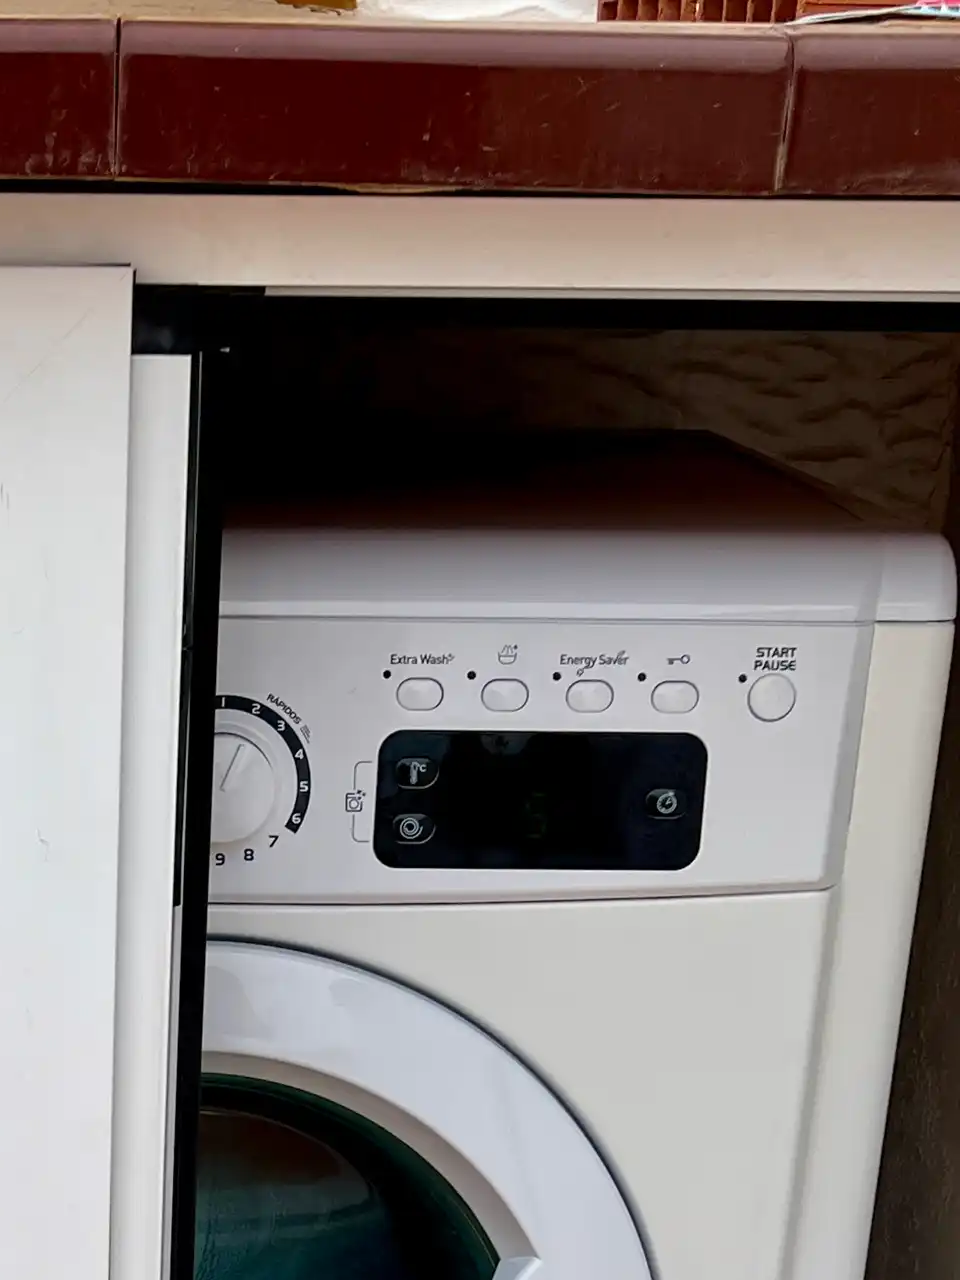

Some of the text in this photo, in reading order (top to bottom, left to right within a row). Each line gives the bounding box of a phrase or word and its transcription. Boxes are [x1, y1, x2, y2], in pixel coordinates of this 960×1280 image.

[756, 647, 797, 658] START
[390, 653, 450, 665] Extra Wash
[560, 652, 629, 669] Energy Saver
[754, 660, 796, 671] PAUSE
[221, 697, 226, 708] 1
[251, 703, 261, 715] 2
[277, 720, 286, 732] 3
[294, 748, 305, 760] 4
[299, 781, 309, 792] 5
[291, 813, 301, 824] 6
[268, 835, 279, 847] 7
[215, 853, 225, 866] 9
[243, 848, 254, 861] 8
